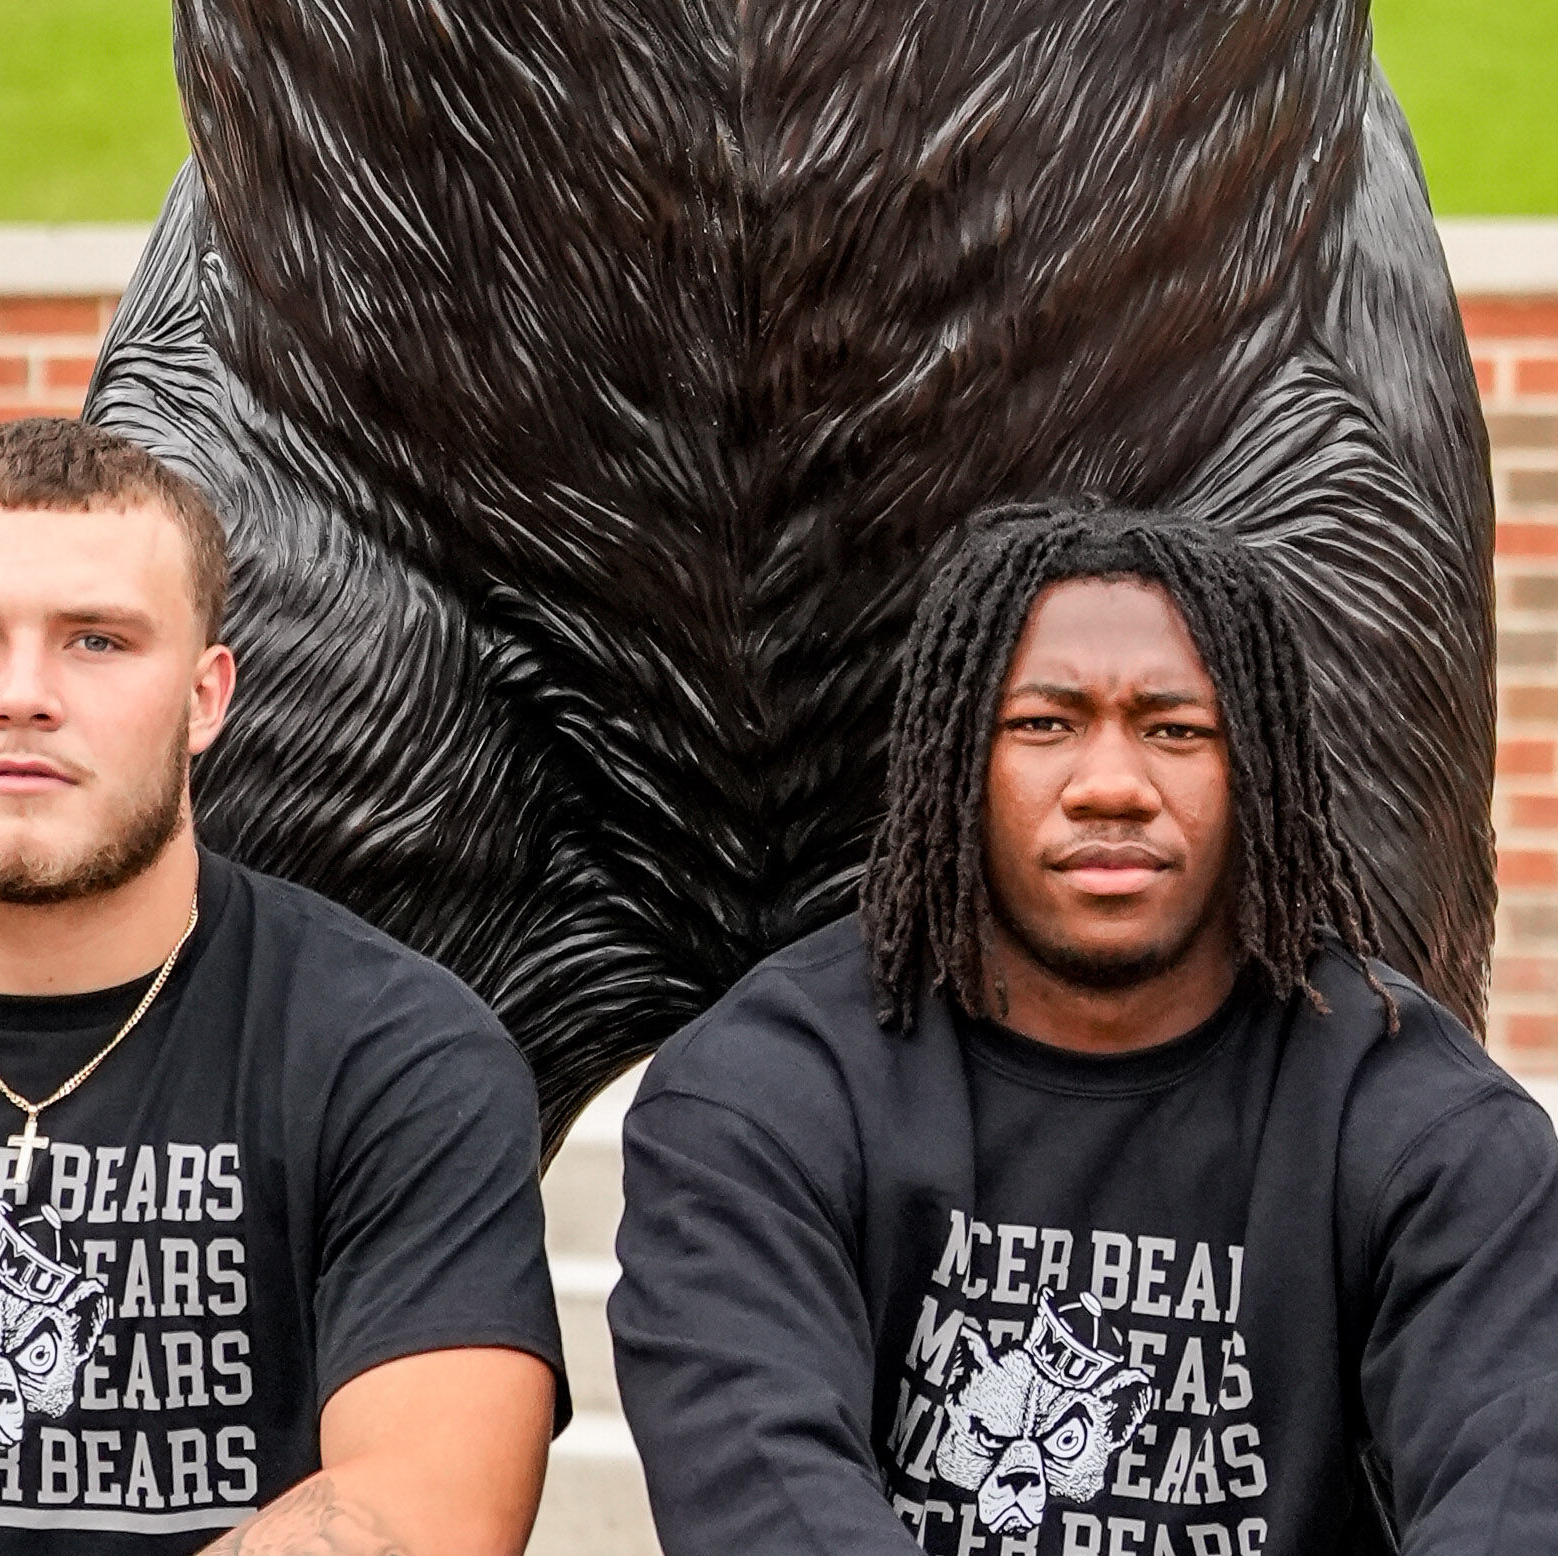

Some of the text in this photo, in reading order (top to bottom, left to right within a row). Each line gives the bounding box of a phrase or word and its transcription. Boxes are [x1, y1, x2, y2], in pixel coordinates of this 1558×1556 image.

[50, 1142, 244, 1223] BEARS
[81, 1238, 247, 1319] EARS
[80, 1330, 253, 1411] EARS
[38, 1425, 258, 1509] BEARS
